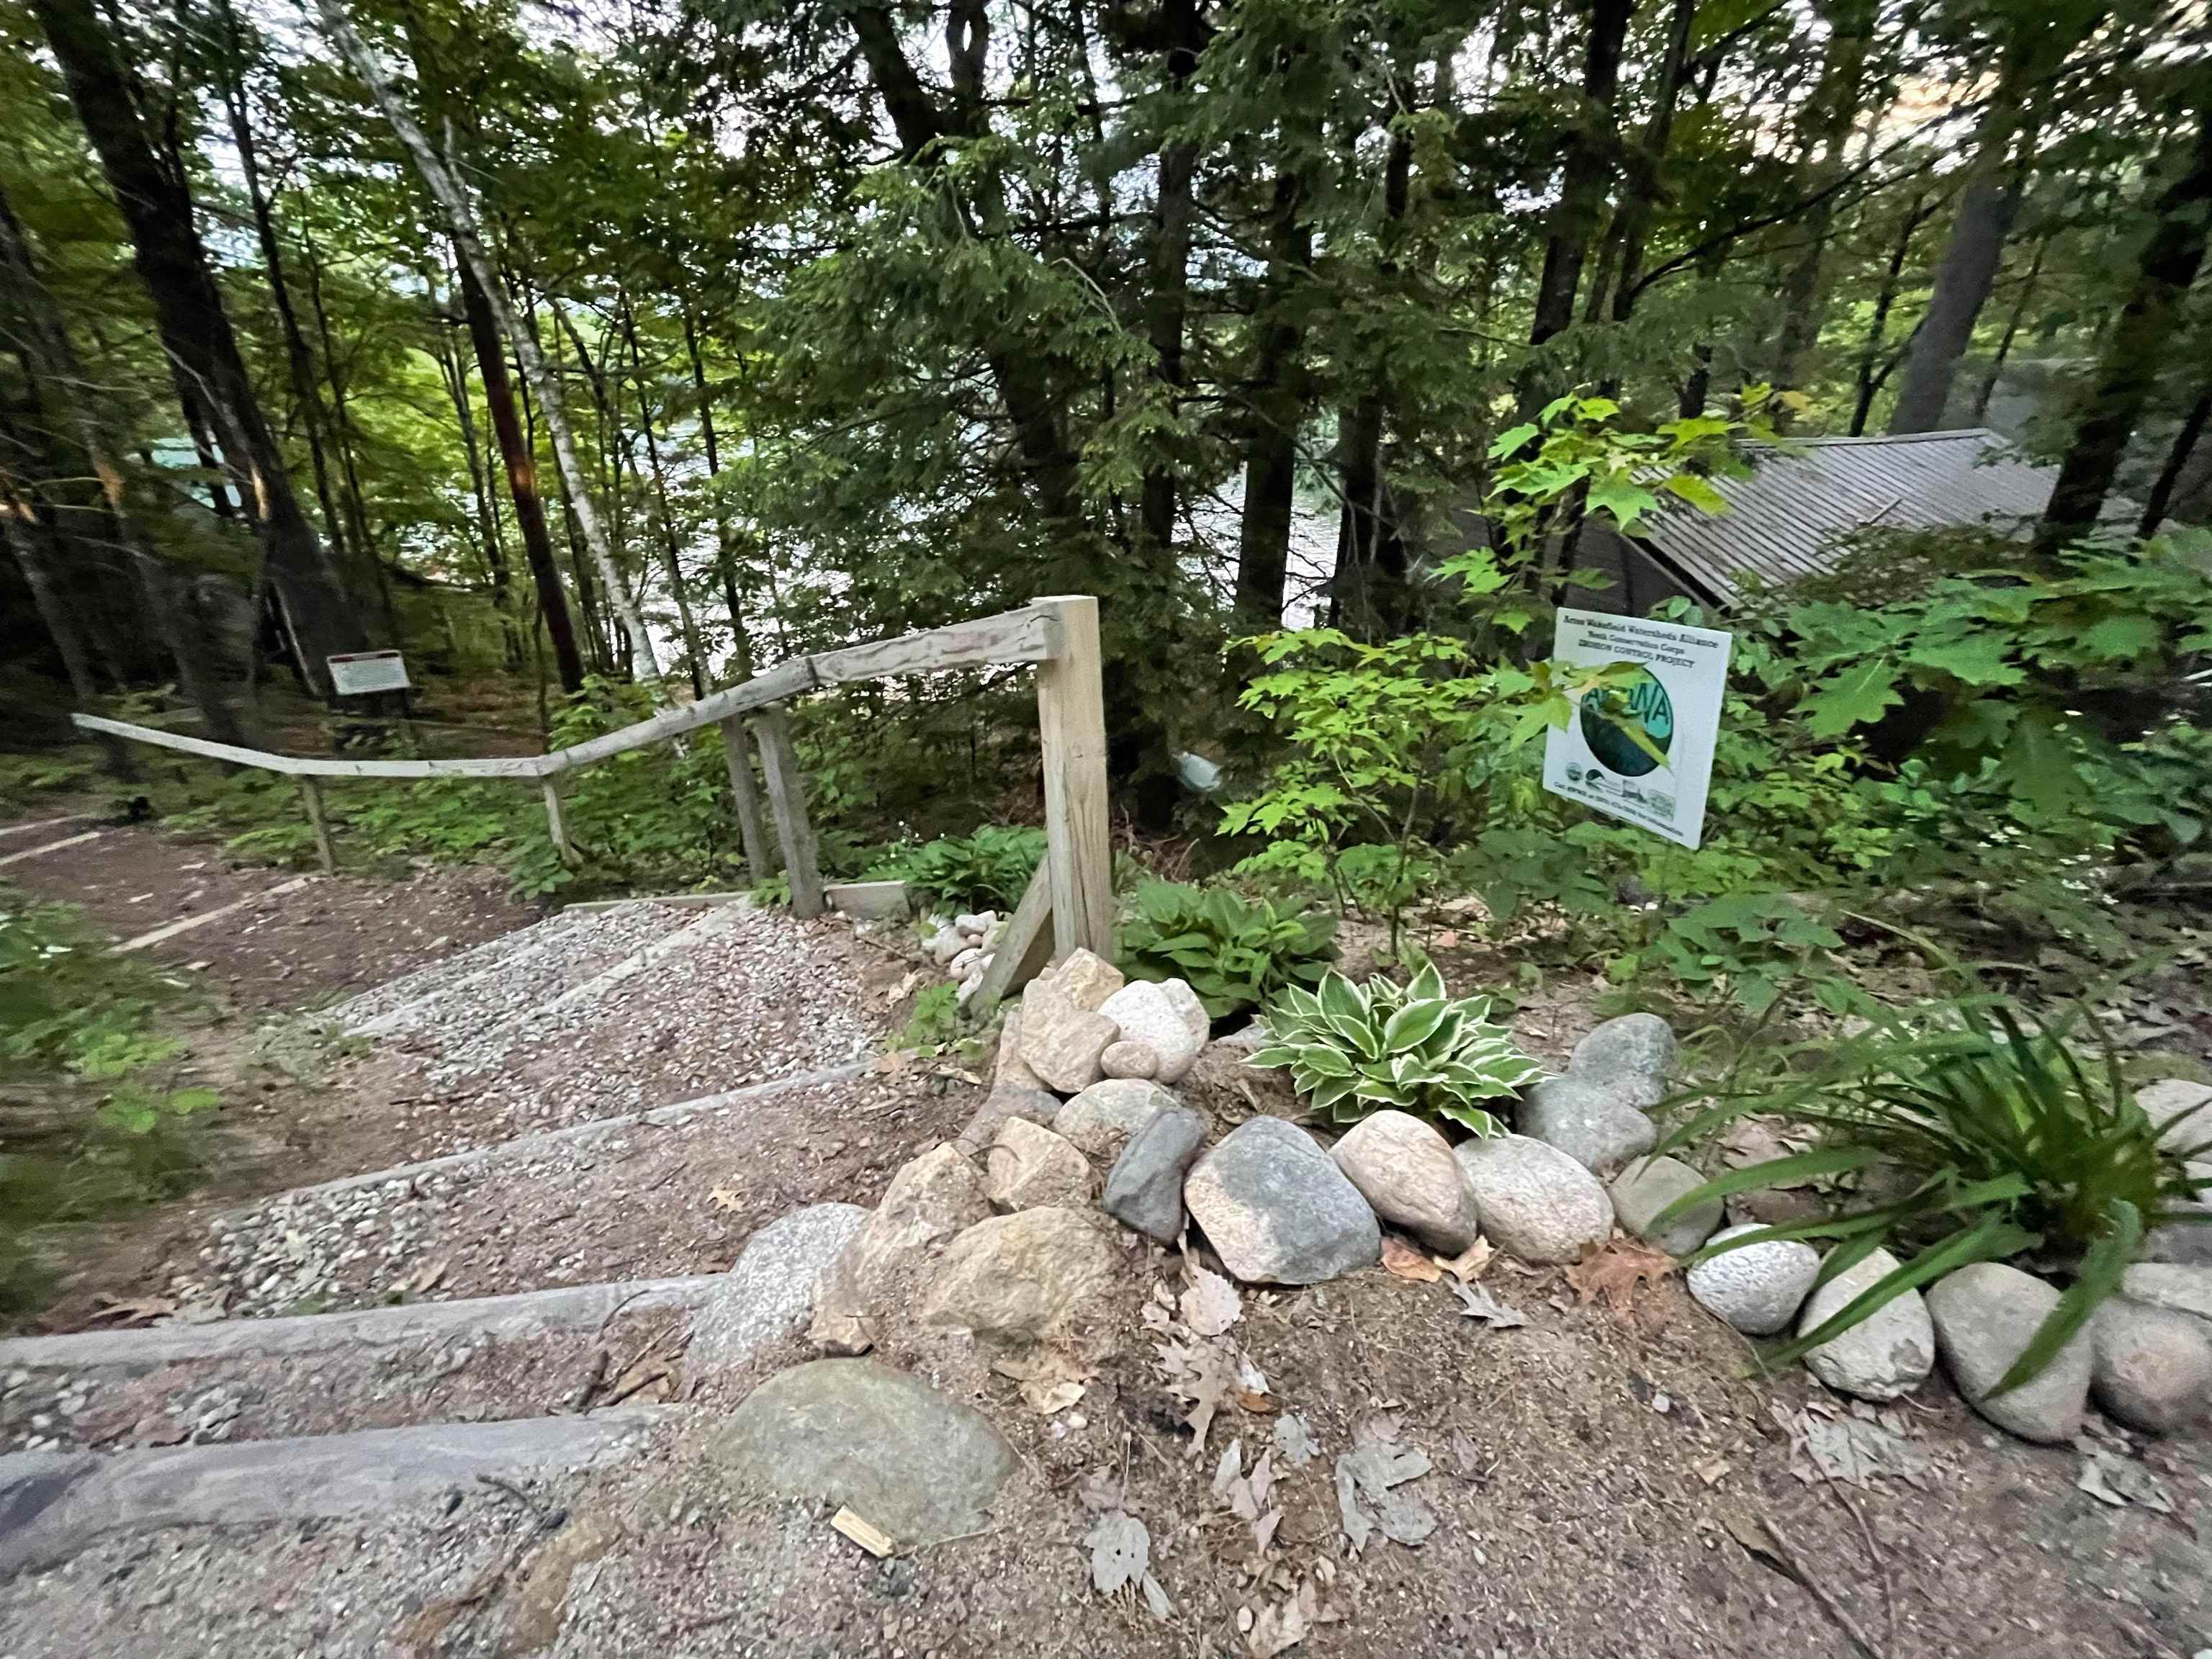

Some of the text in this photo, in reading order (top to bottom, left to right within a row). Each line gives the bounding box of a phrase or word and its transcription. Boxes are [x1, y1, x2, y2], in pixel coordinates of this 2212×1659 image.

[1679, 634, 1718, 648] Alliance
[1660, 644, 1685, 655] Corps
[1614, 647, 1654, 660] CONTROL
[1655, 654, 1695, 668] PROJECT
